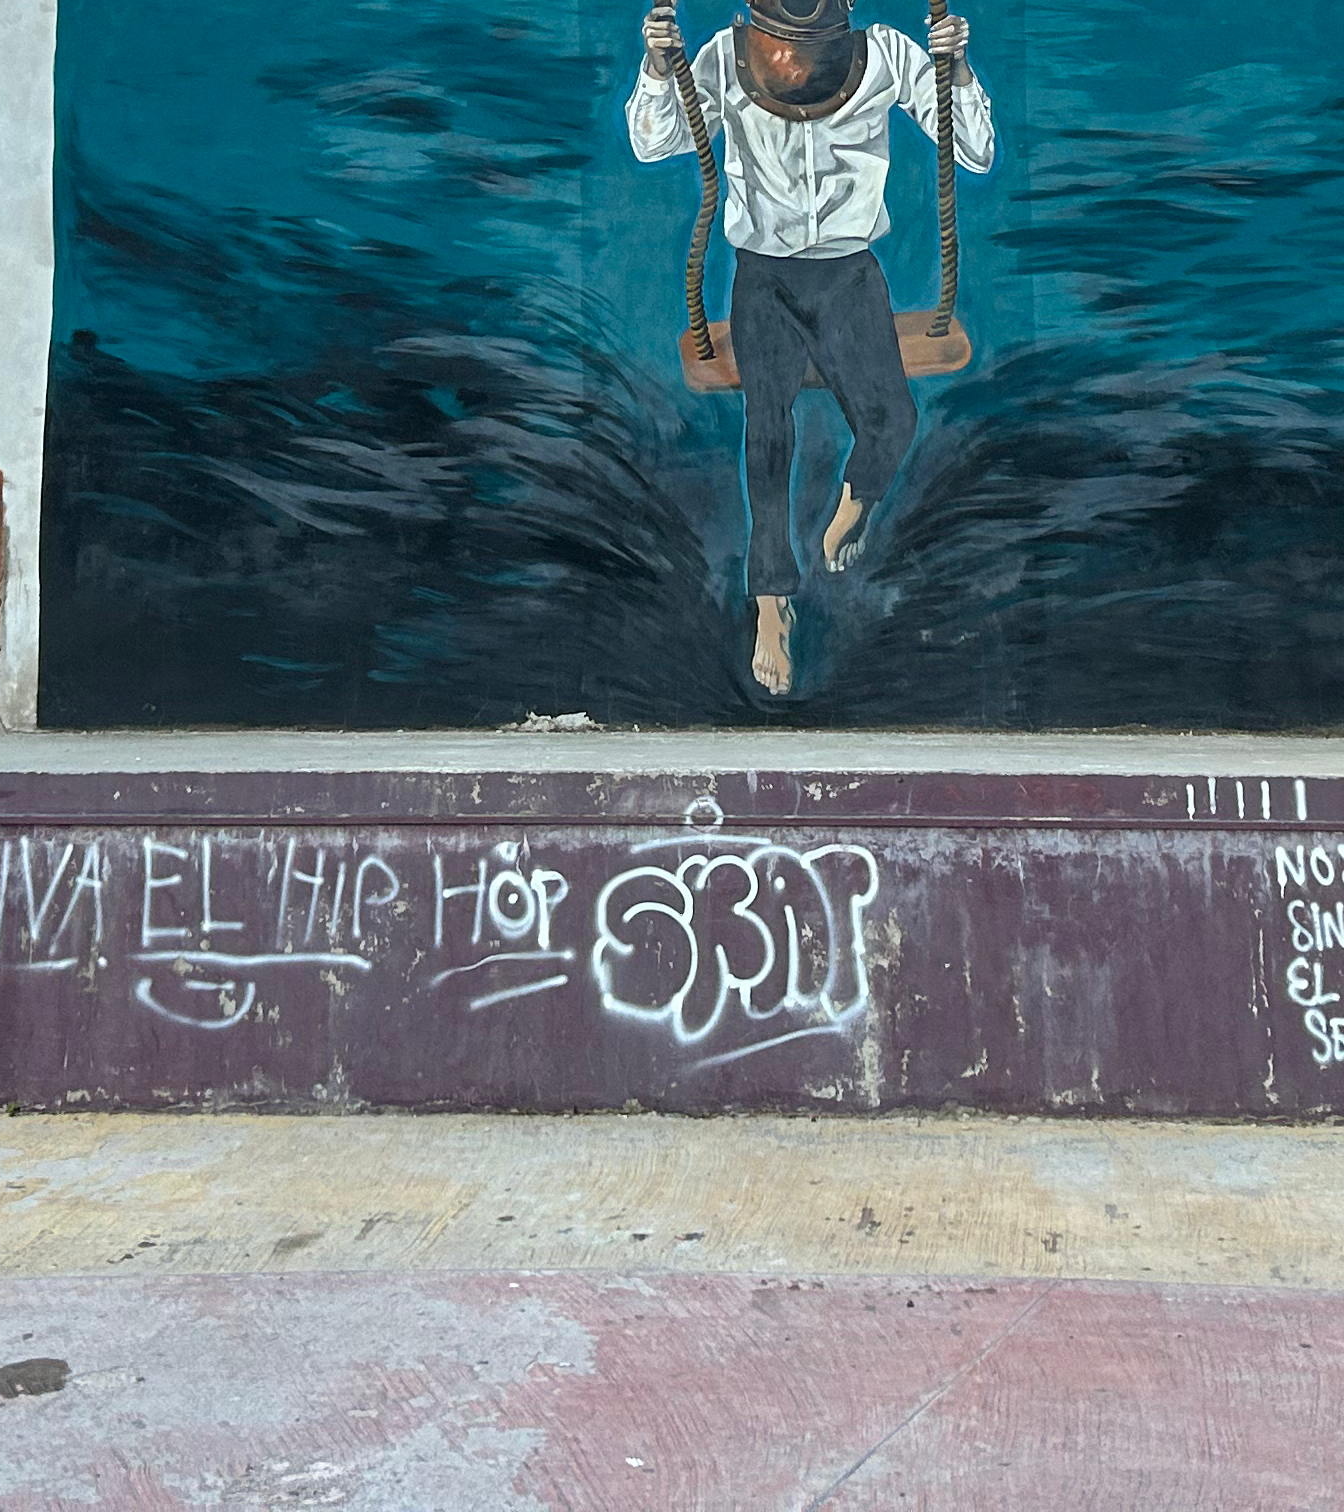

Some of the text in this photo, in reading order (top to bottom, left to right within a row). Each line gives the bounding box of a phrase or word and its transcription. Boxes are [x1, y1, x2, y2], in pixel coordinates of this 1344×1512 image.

[142, 835, 246, 947] EL
[275, 835, 401, 950] HIP
[432, 840, 569, 950] HOP
[1286, 956, 1340, 1006] EL
